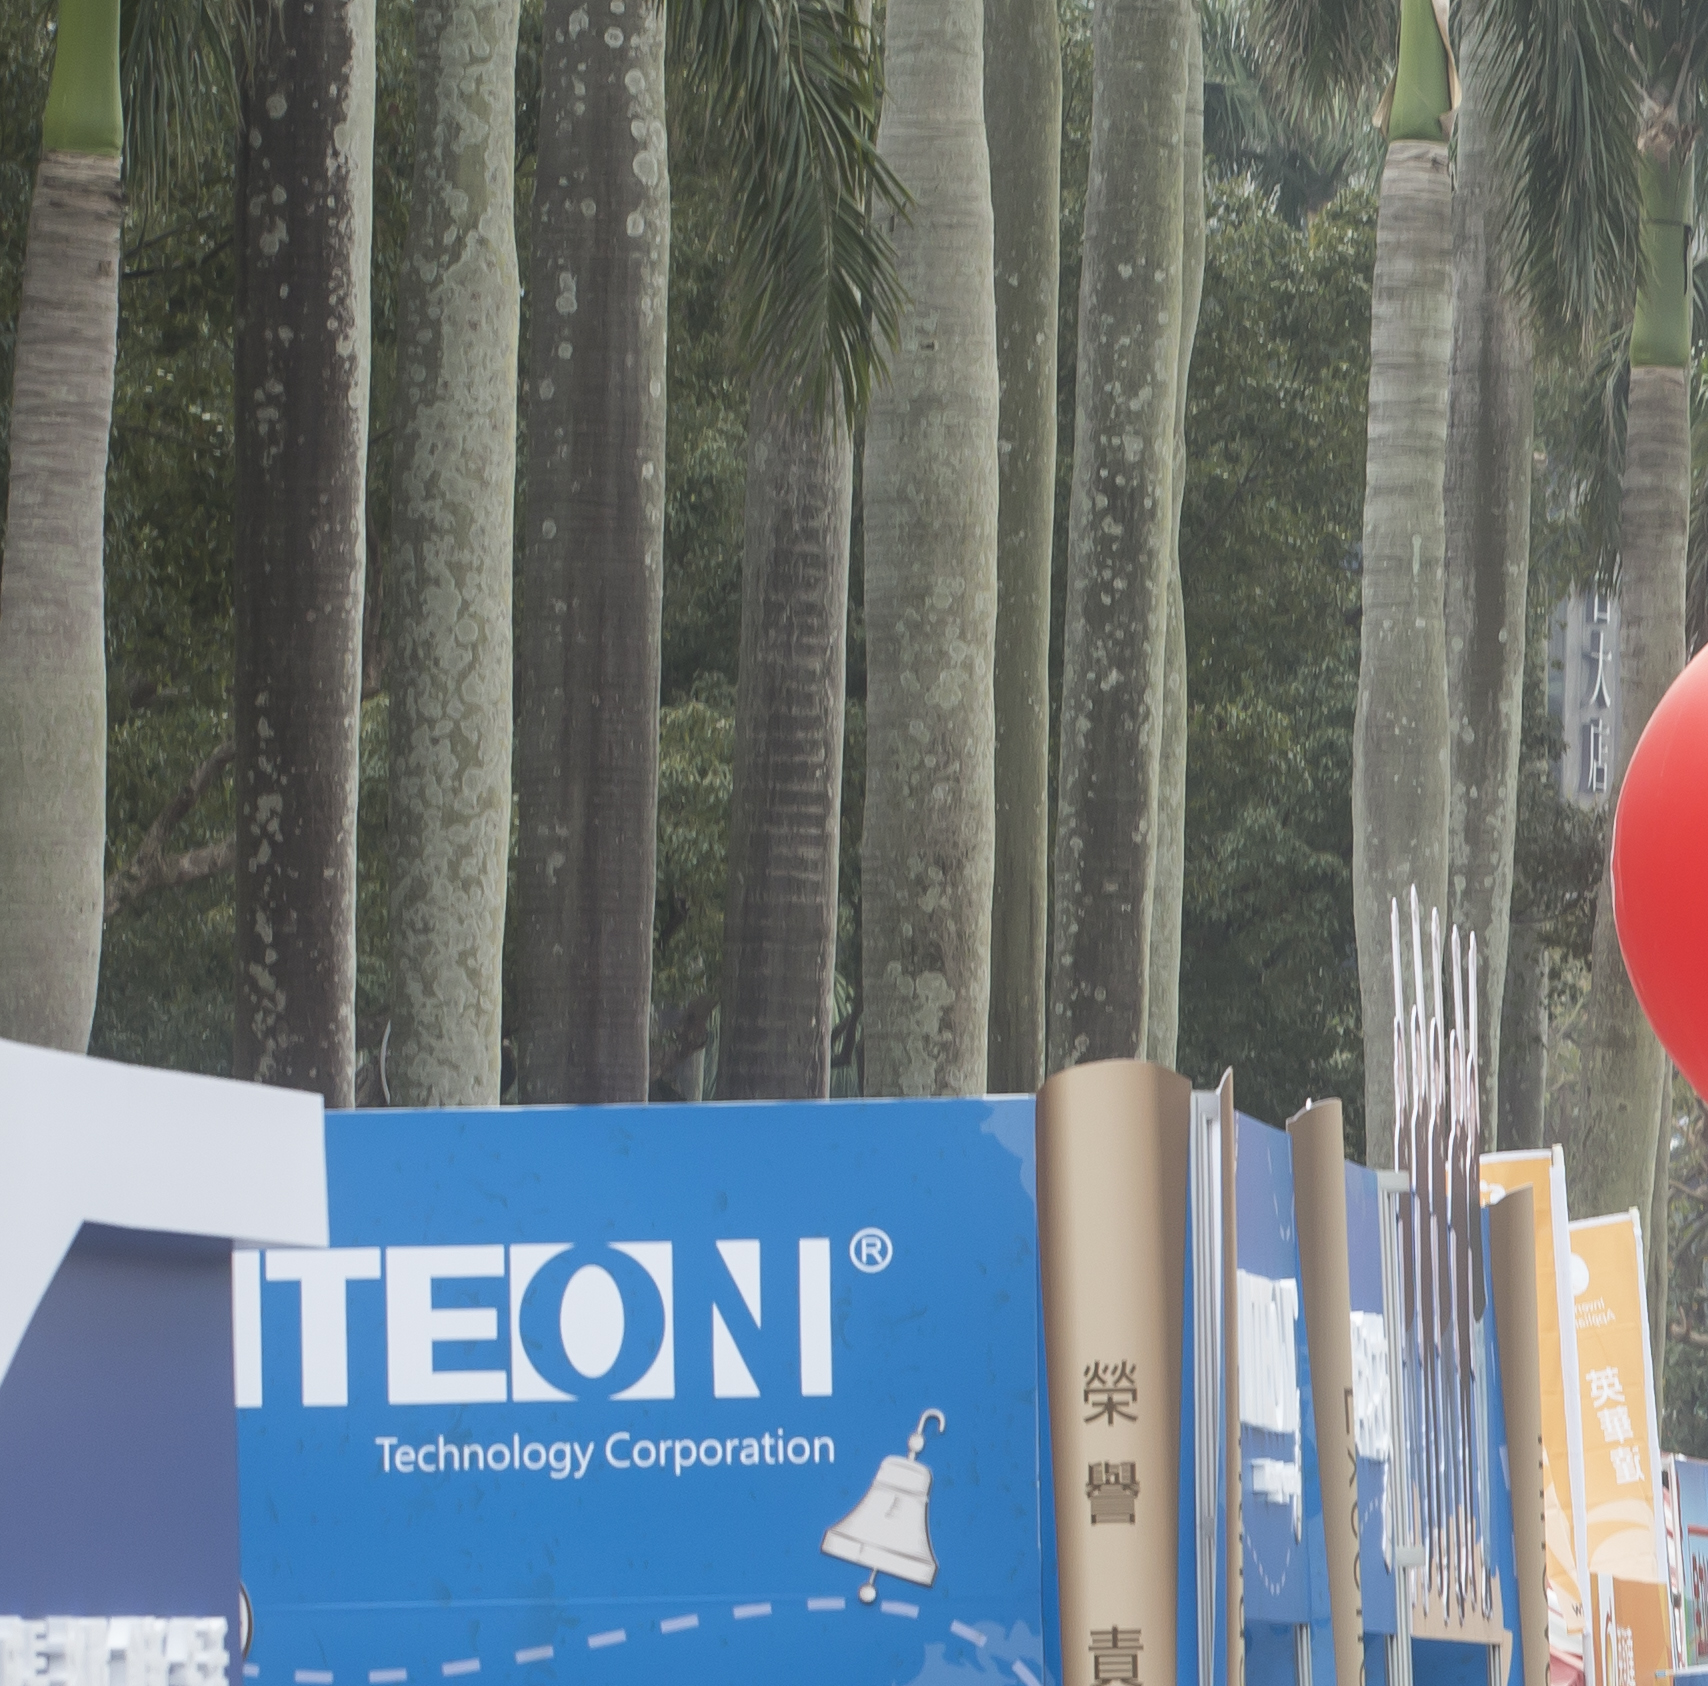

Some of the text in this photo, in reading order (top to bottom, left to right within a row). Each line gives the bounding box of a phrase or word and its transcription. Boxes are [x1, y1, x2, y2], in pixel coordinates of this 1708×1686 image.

[234, 1238, 832, 1407] ITEON
[375, 1429, 835, 1479] Technology Corporation
